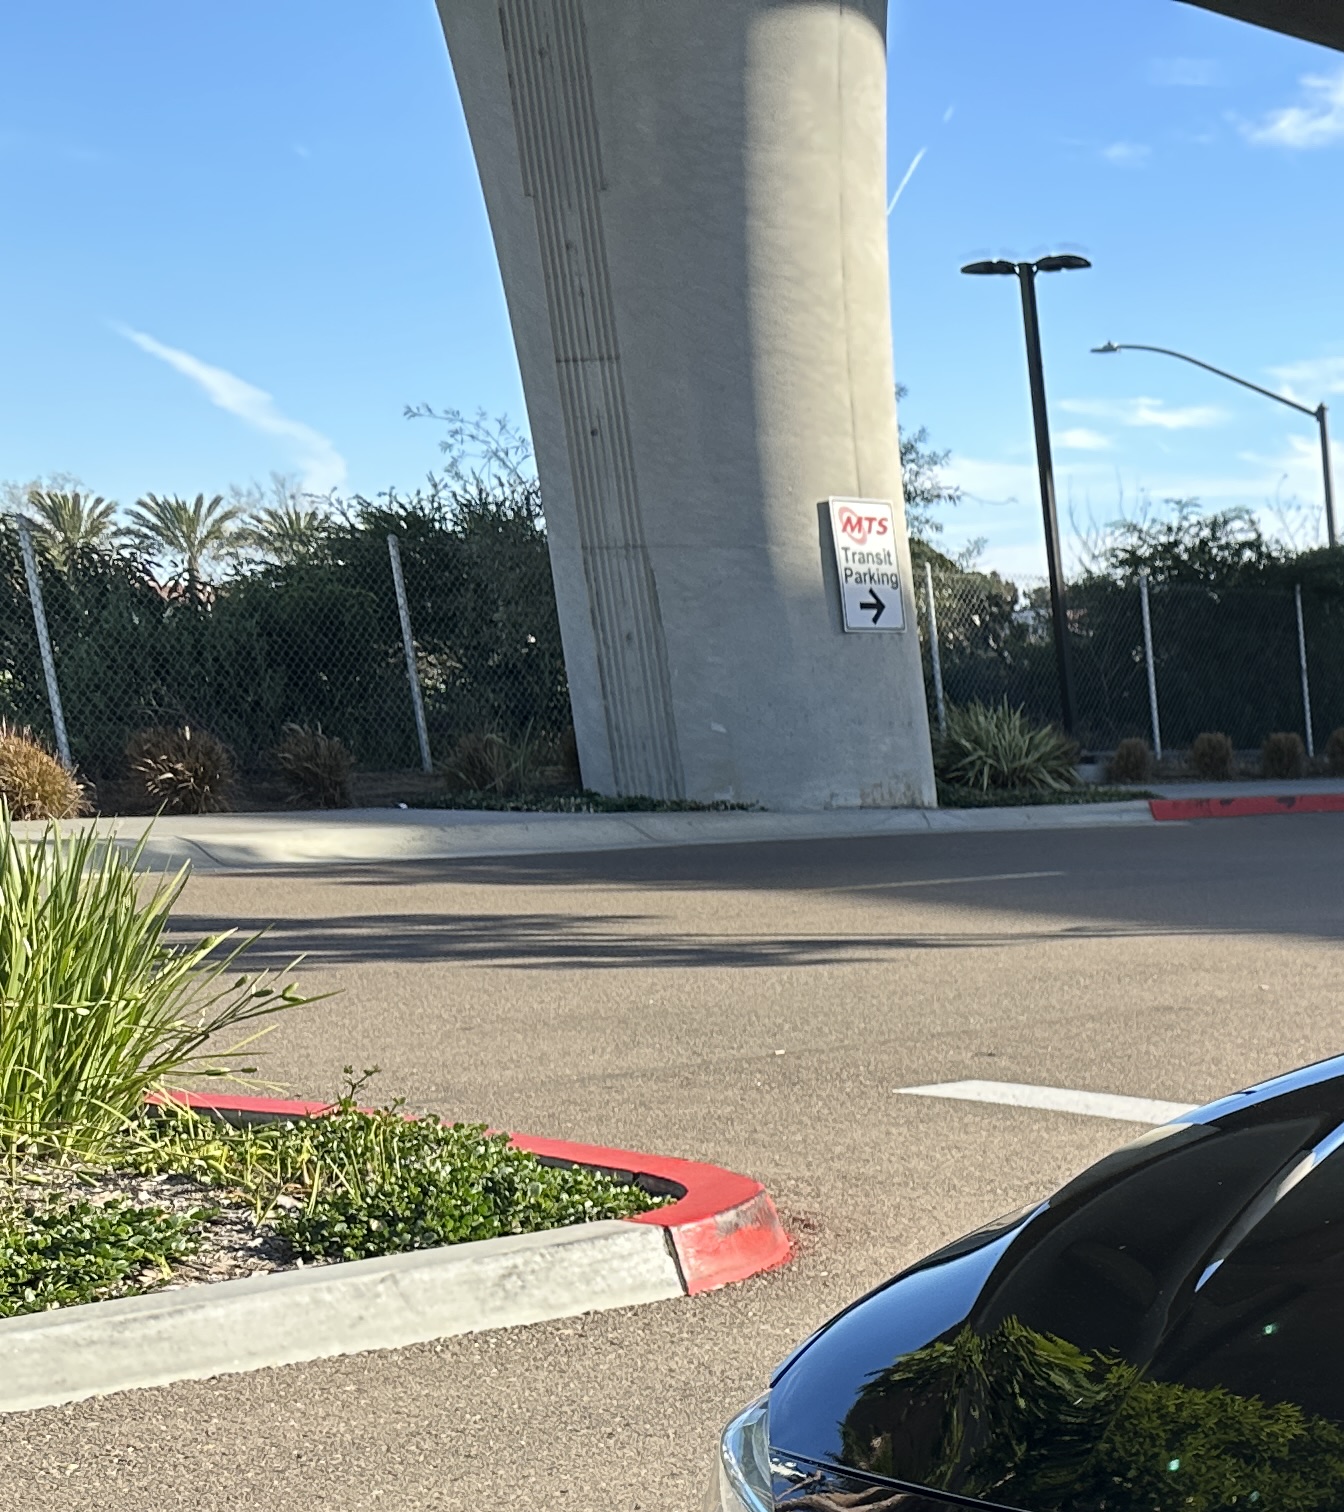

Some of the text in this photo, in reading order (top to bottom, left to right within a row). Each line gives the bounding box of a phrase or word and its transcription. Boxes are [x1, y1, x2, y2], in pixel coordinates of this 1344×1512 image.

[841, 515, 889, 536] MTS
[841, 546, 893, 566] Transit
[844, 567, 899, 590] Parking
